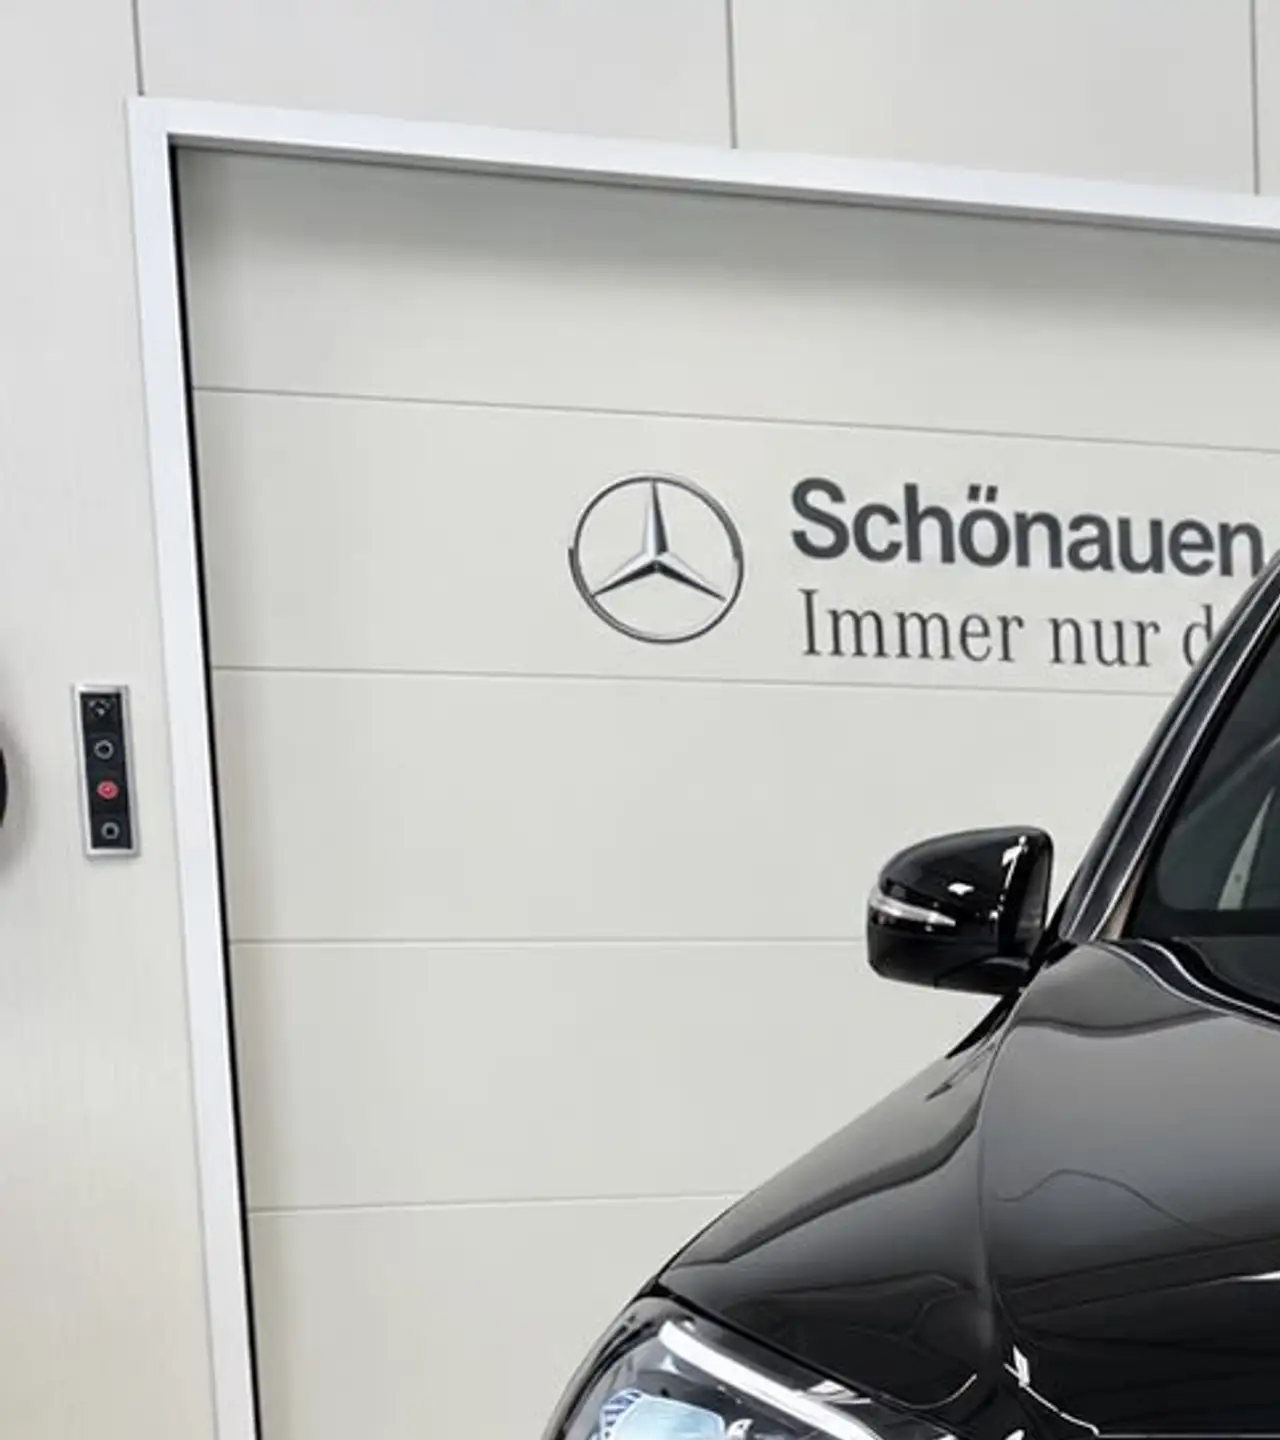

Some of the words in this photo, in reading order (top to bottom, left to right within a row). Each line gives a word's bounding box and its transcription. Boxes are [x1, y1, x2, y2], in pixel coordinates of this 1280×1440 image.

[791, 477, 1266, 577] Schönauen
[800, 589, 1025, 662] Immer
[1049, 616, 1161, 668] nur
